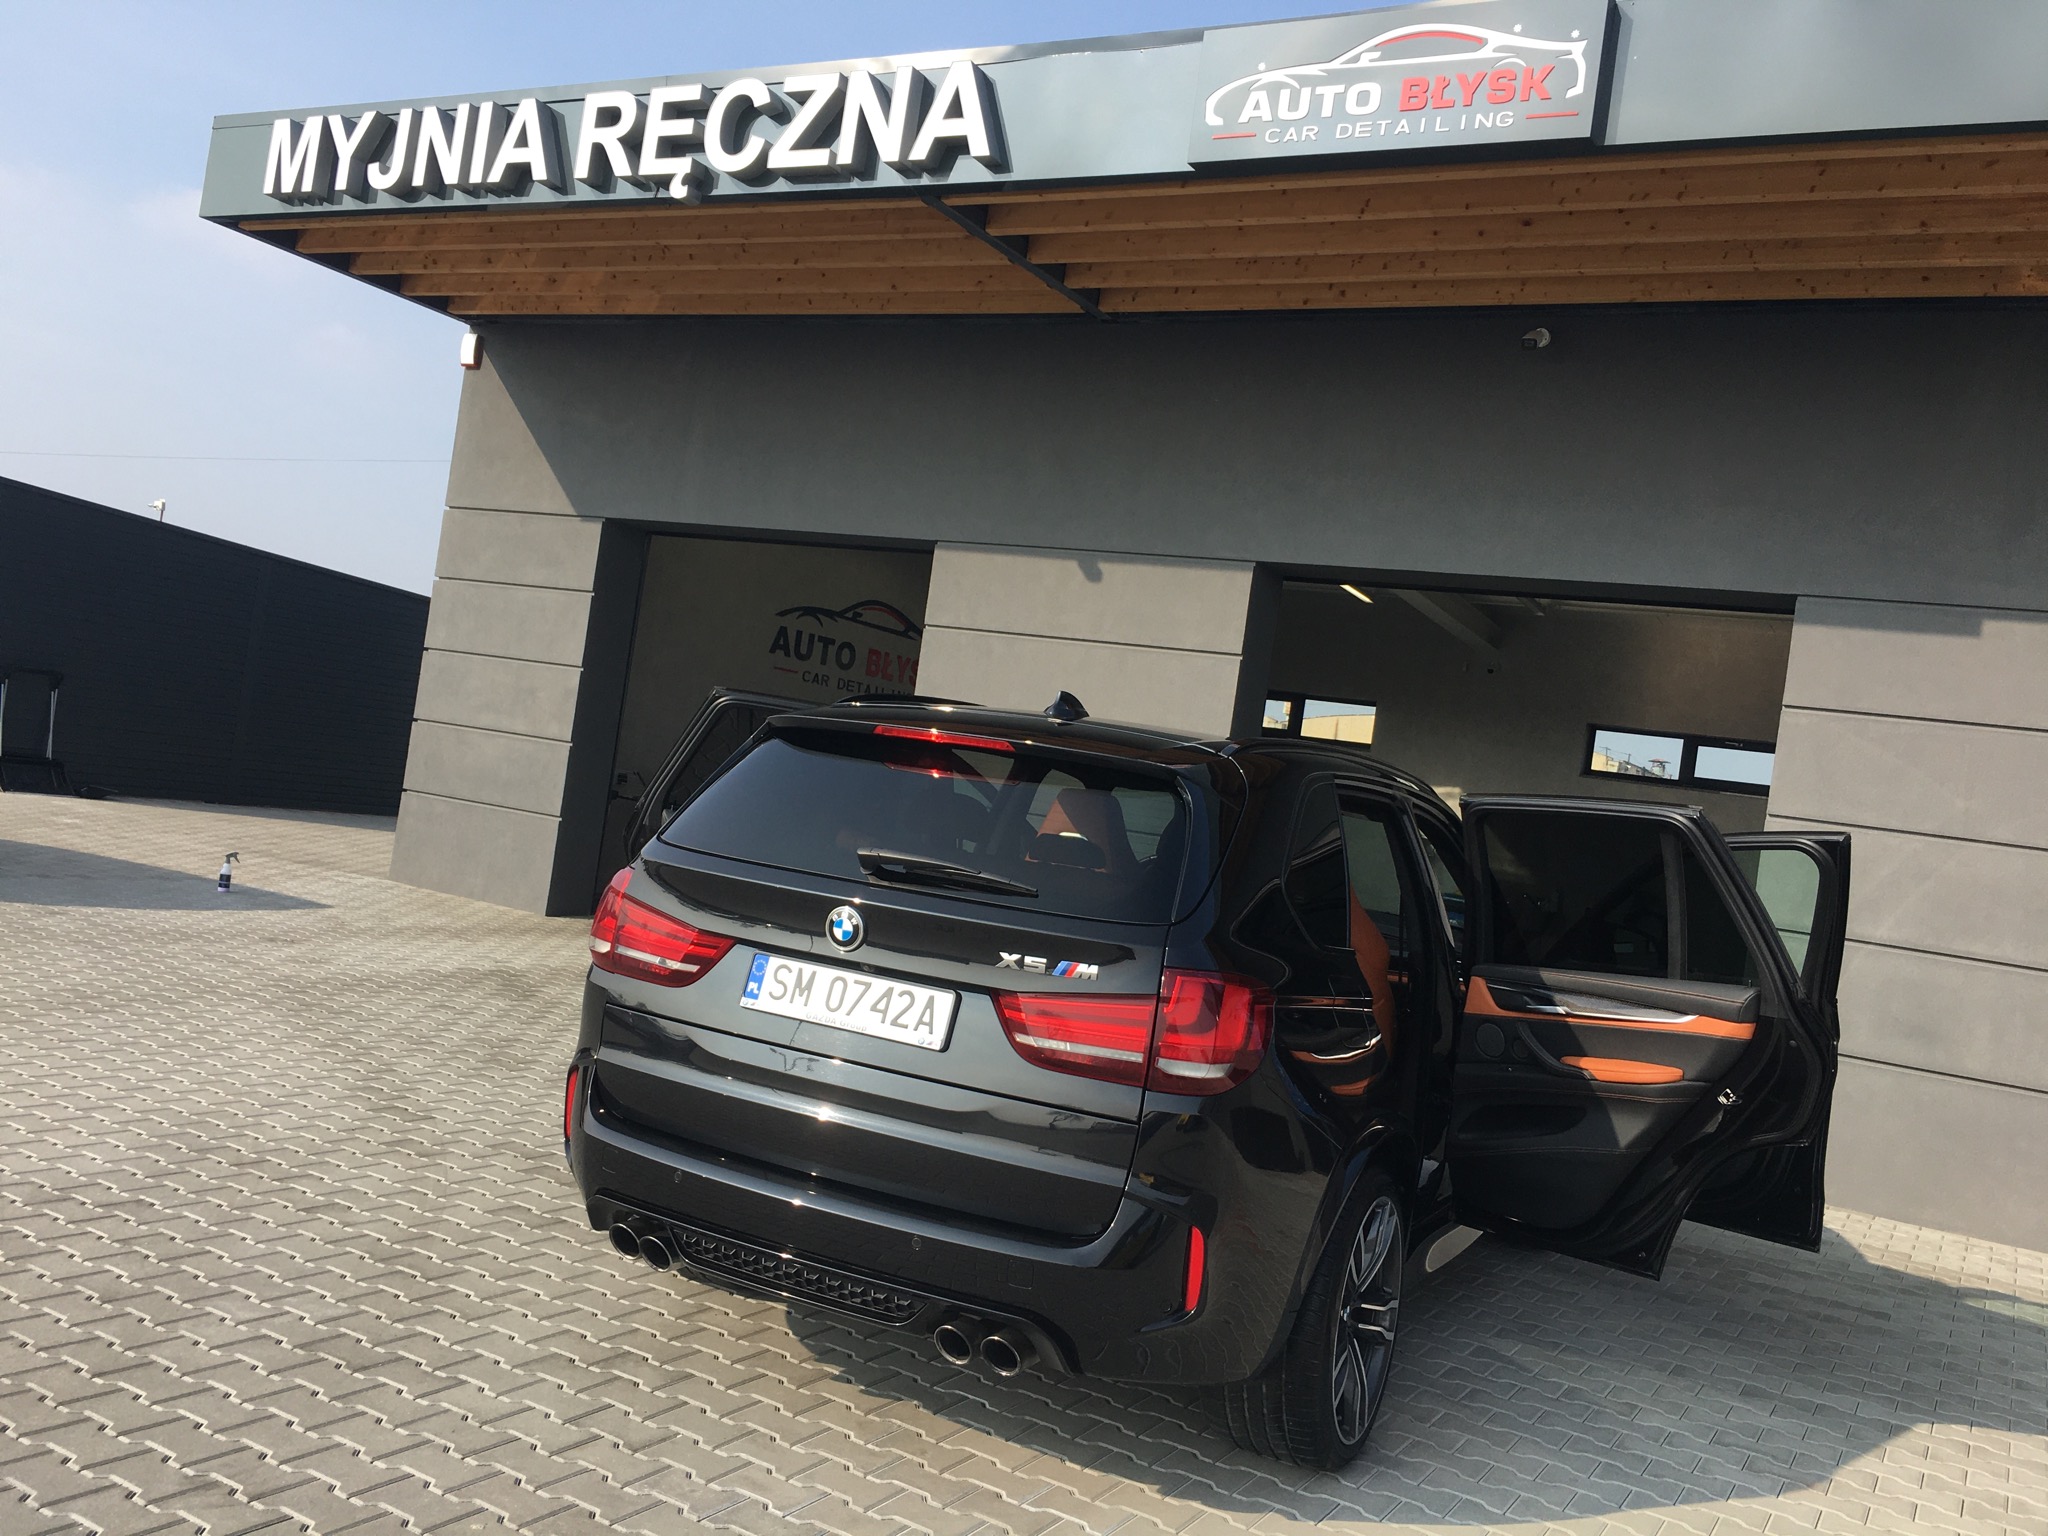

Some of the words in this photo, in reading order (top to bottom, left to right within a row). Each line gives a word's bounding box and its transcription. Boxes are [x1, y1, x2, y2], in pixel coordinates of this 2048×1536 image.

[1237, 82, 1382, 124] AUTO
[1398, 64, 1556, 112] BŁYSK
[263, 97, 550, 197] MYJNIA
[574, 60, 995, 200] RĘCZNA
[1264, 125, 1320, 144] CAR
[1335, 111, 1515, 140] DETAILING
[768, 625, 857, 671] AUTO
[802, 671, 830, 687] CAR
[995, 951, 1047, 974] X5
[747, 981, 760, 994] PL
[769, 963, 817, 1007] SM
[825, 975, 935, 1035] 0742A
